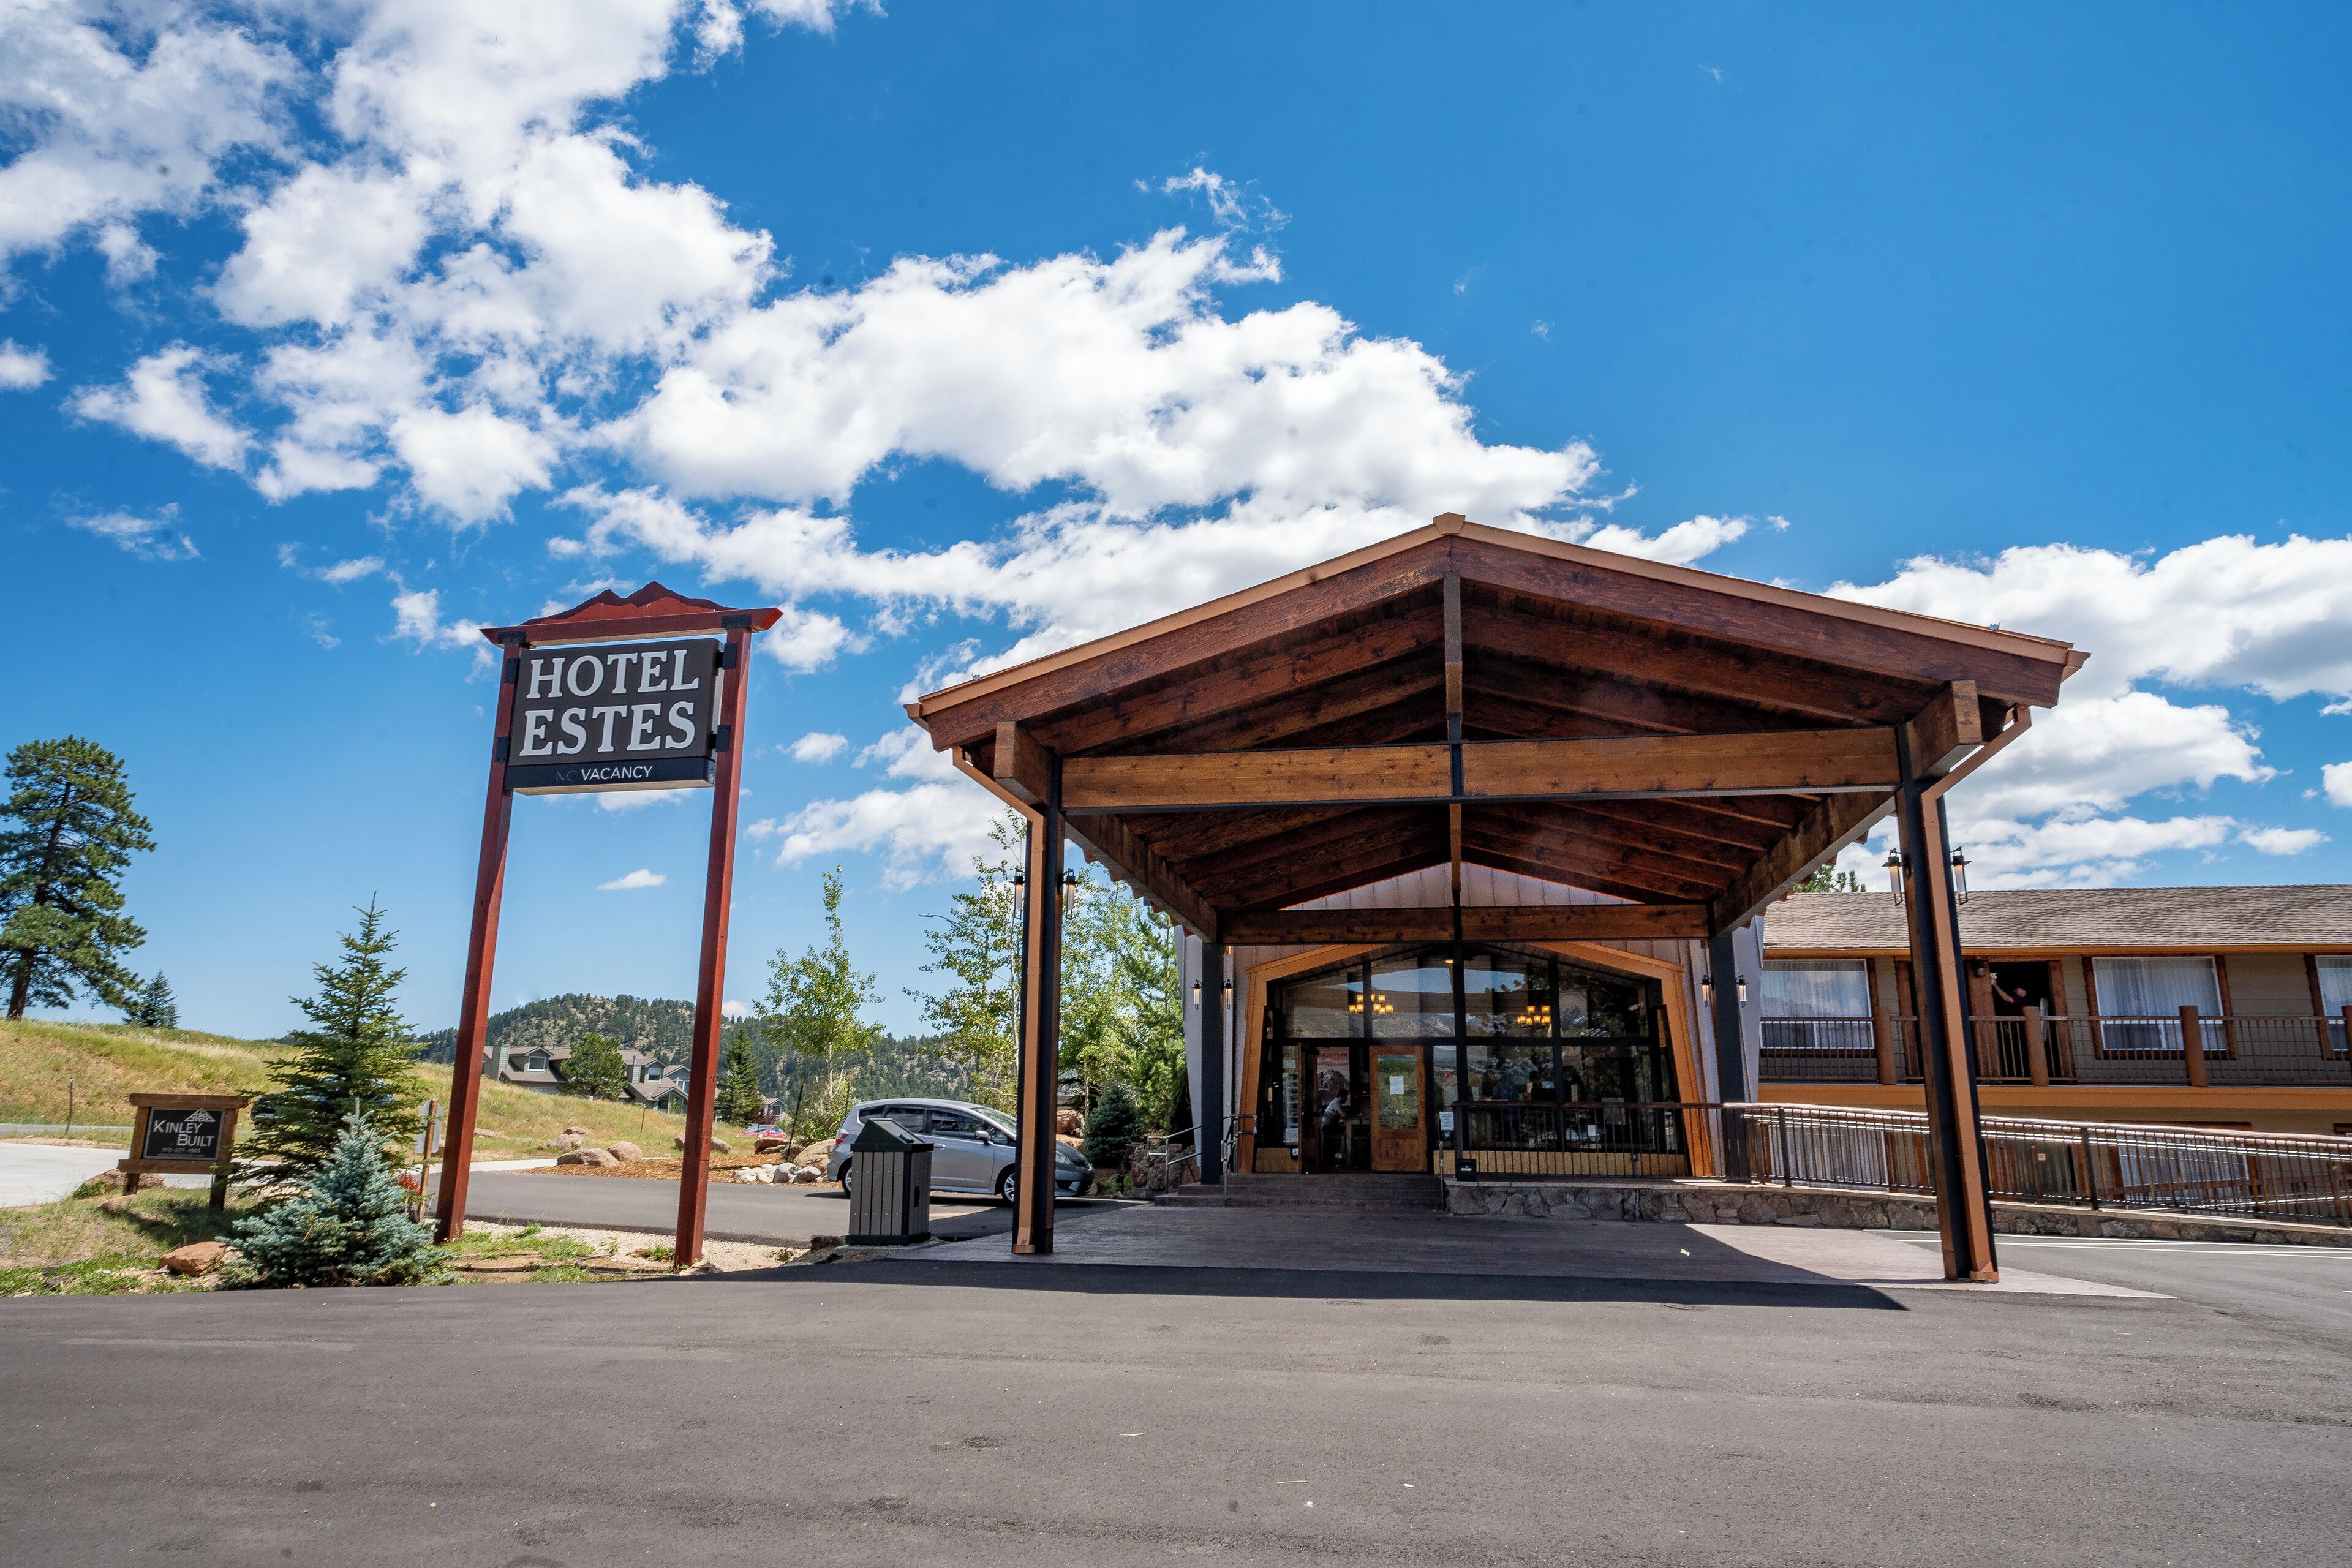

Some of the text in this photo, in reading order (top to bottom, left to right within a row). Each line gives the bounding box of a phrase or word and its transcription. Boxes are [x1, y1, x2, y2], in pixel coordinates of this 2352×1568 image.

[526, 650, 699, 699] HOTEL
[519, 701, 696, 756] ESTES
[581, 766, 653, 780] VACANCY
[154, 1120, 203, 1133] KINLEY
[176, 1134, 215, 1147] BUILT
